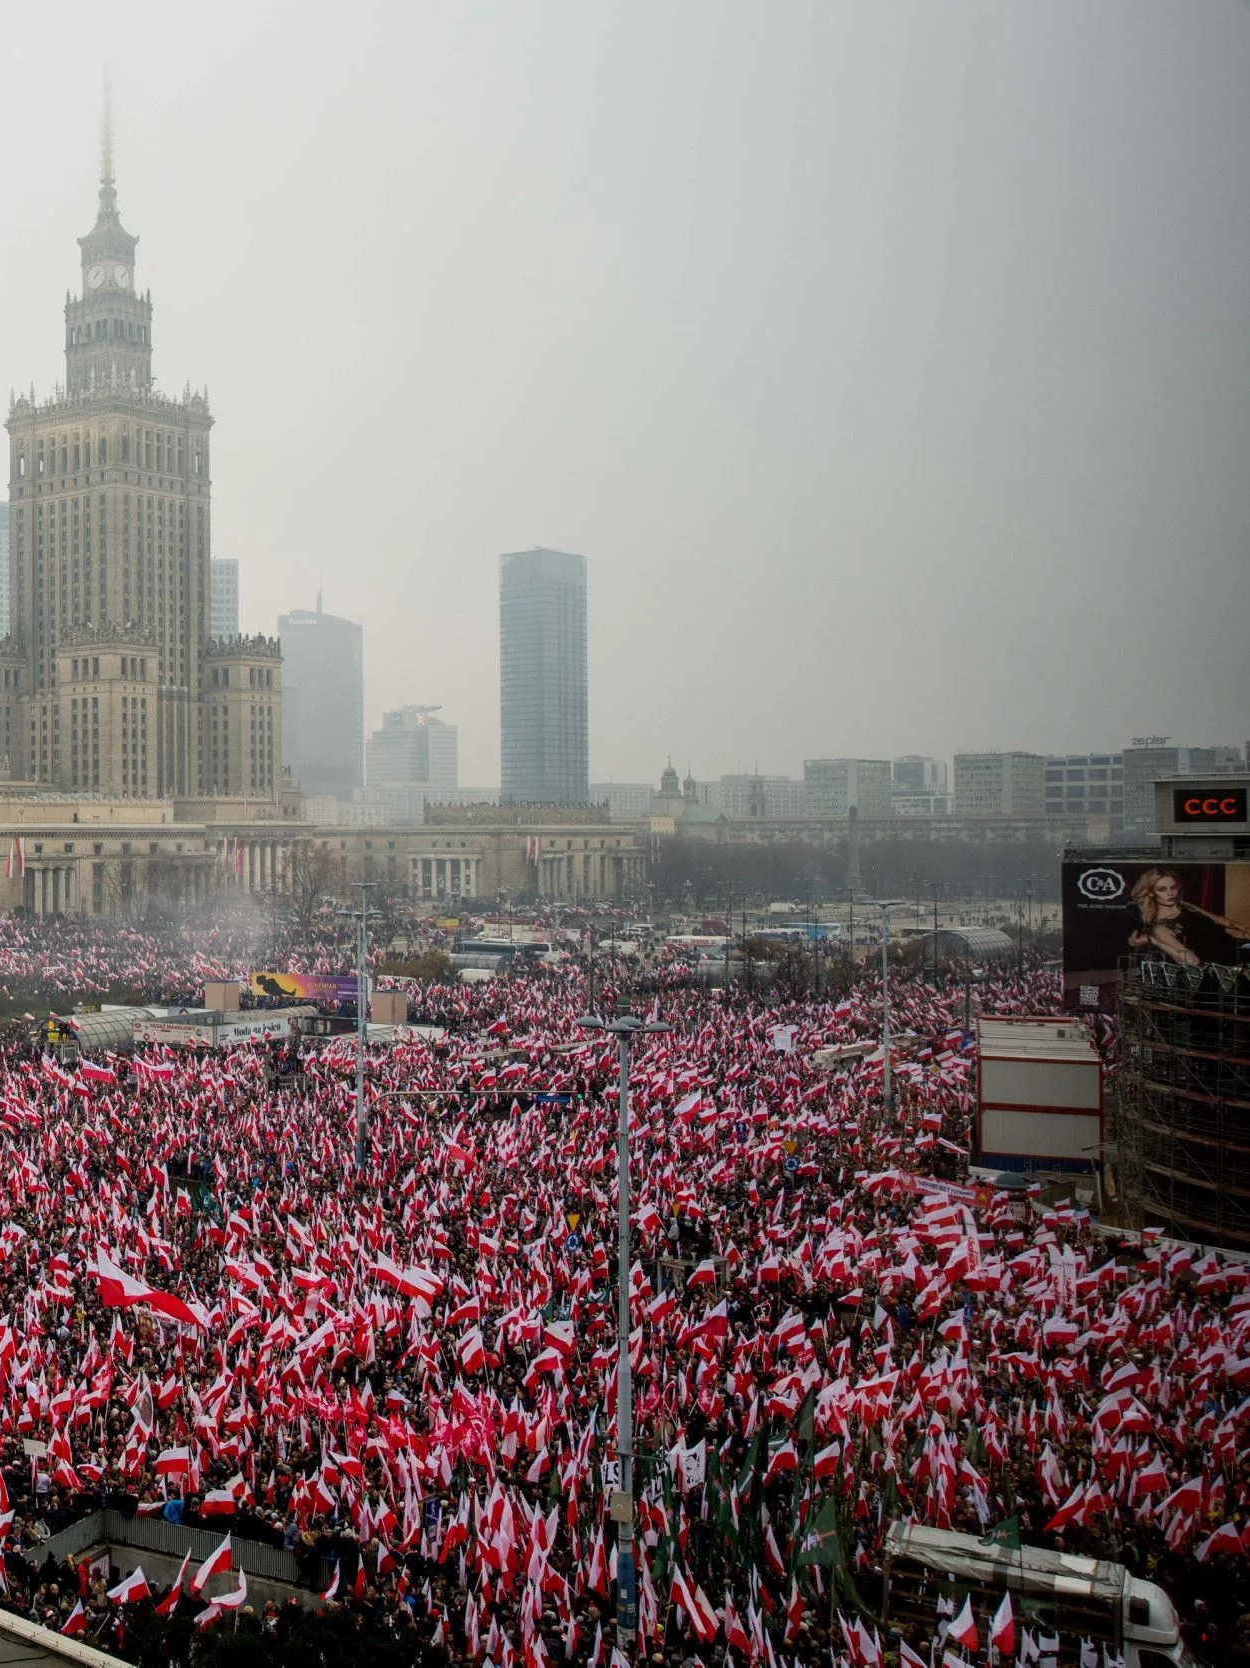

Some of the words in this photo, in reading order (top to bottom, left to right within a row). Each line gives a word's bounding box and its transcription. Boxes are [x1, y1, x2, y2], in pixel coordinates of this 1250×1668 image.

[1184, 798, 1237, 815] CCC
[1086, 876, 1117, 891] C&A
[234, 1026, 252, 1037] Moda
